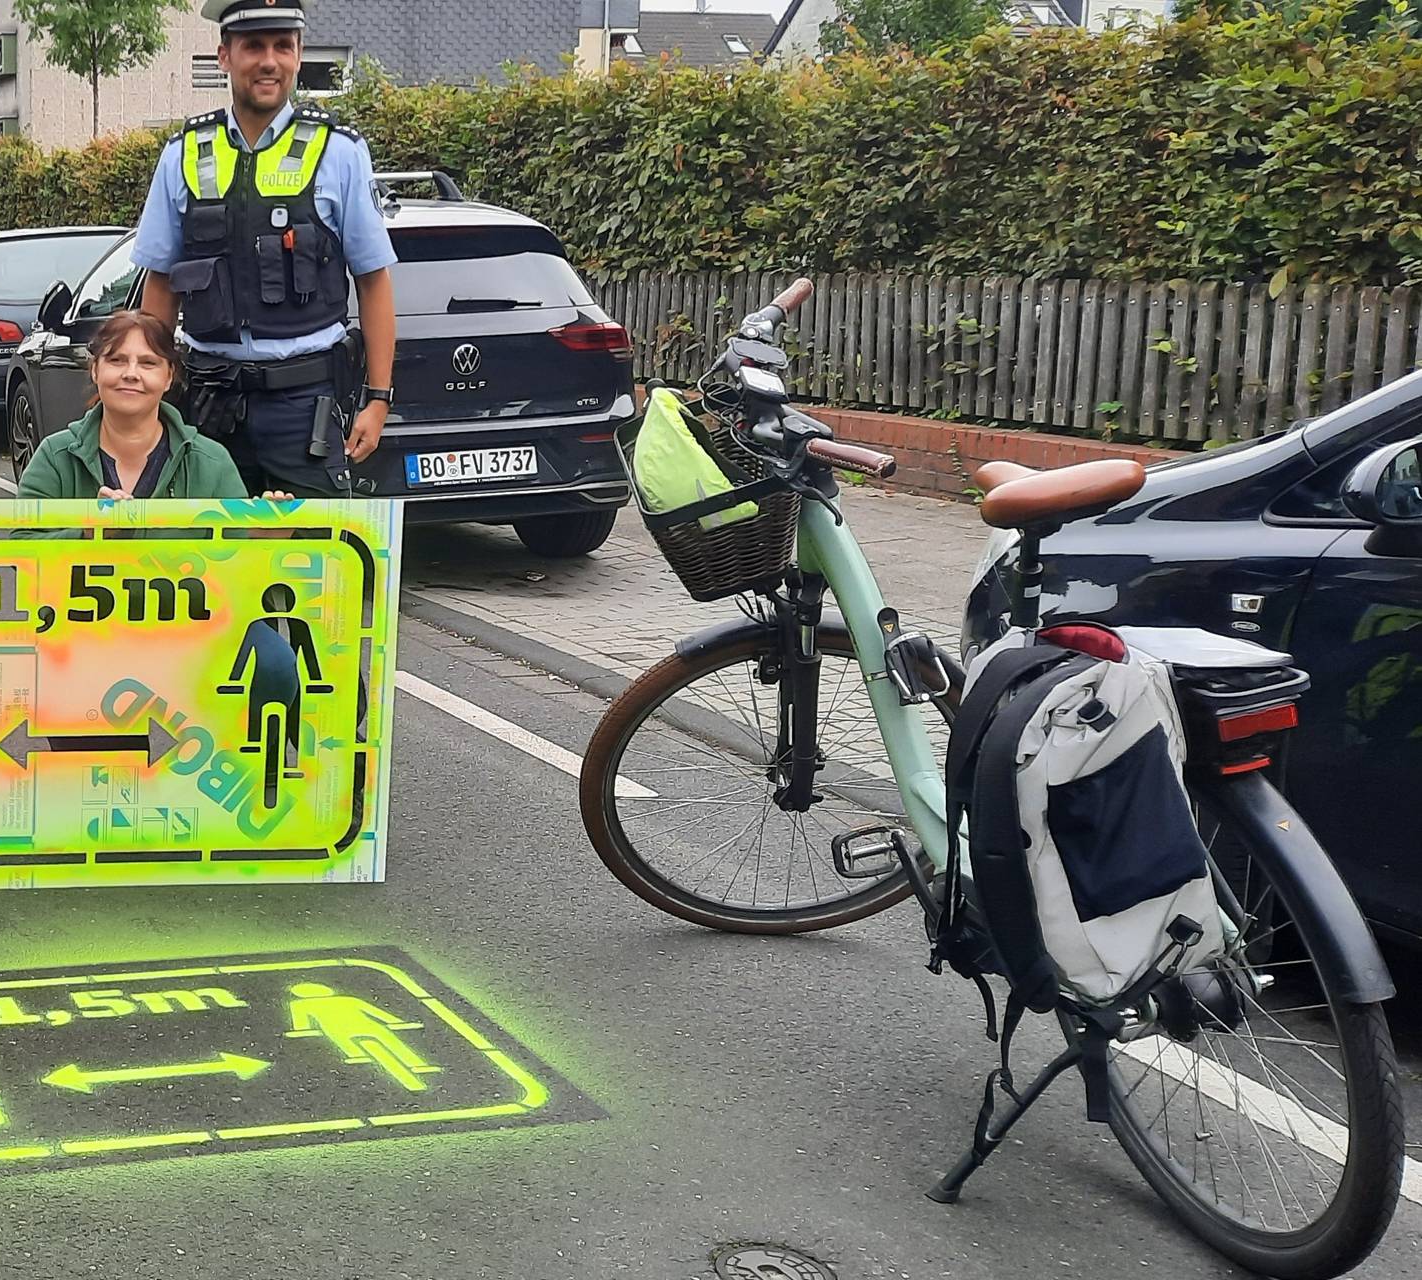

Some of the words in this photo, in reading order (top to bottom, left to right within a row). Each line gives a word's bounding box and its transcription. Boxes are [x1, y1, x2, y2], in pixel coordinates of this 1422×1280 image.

[261, 171, 304, 188] POLIZEI
[445, 381, 487, 391] GOLF
[577, 398, 599, 406] eTSI
[420, 456, 446, 478] BO
[460, 452, 484, 475] FV
[489, 448, 534, 474] 3737
